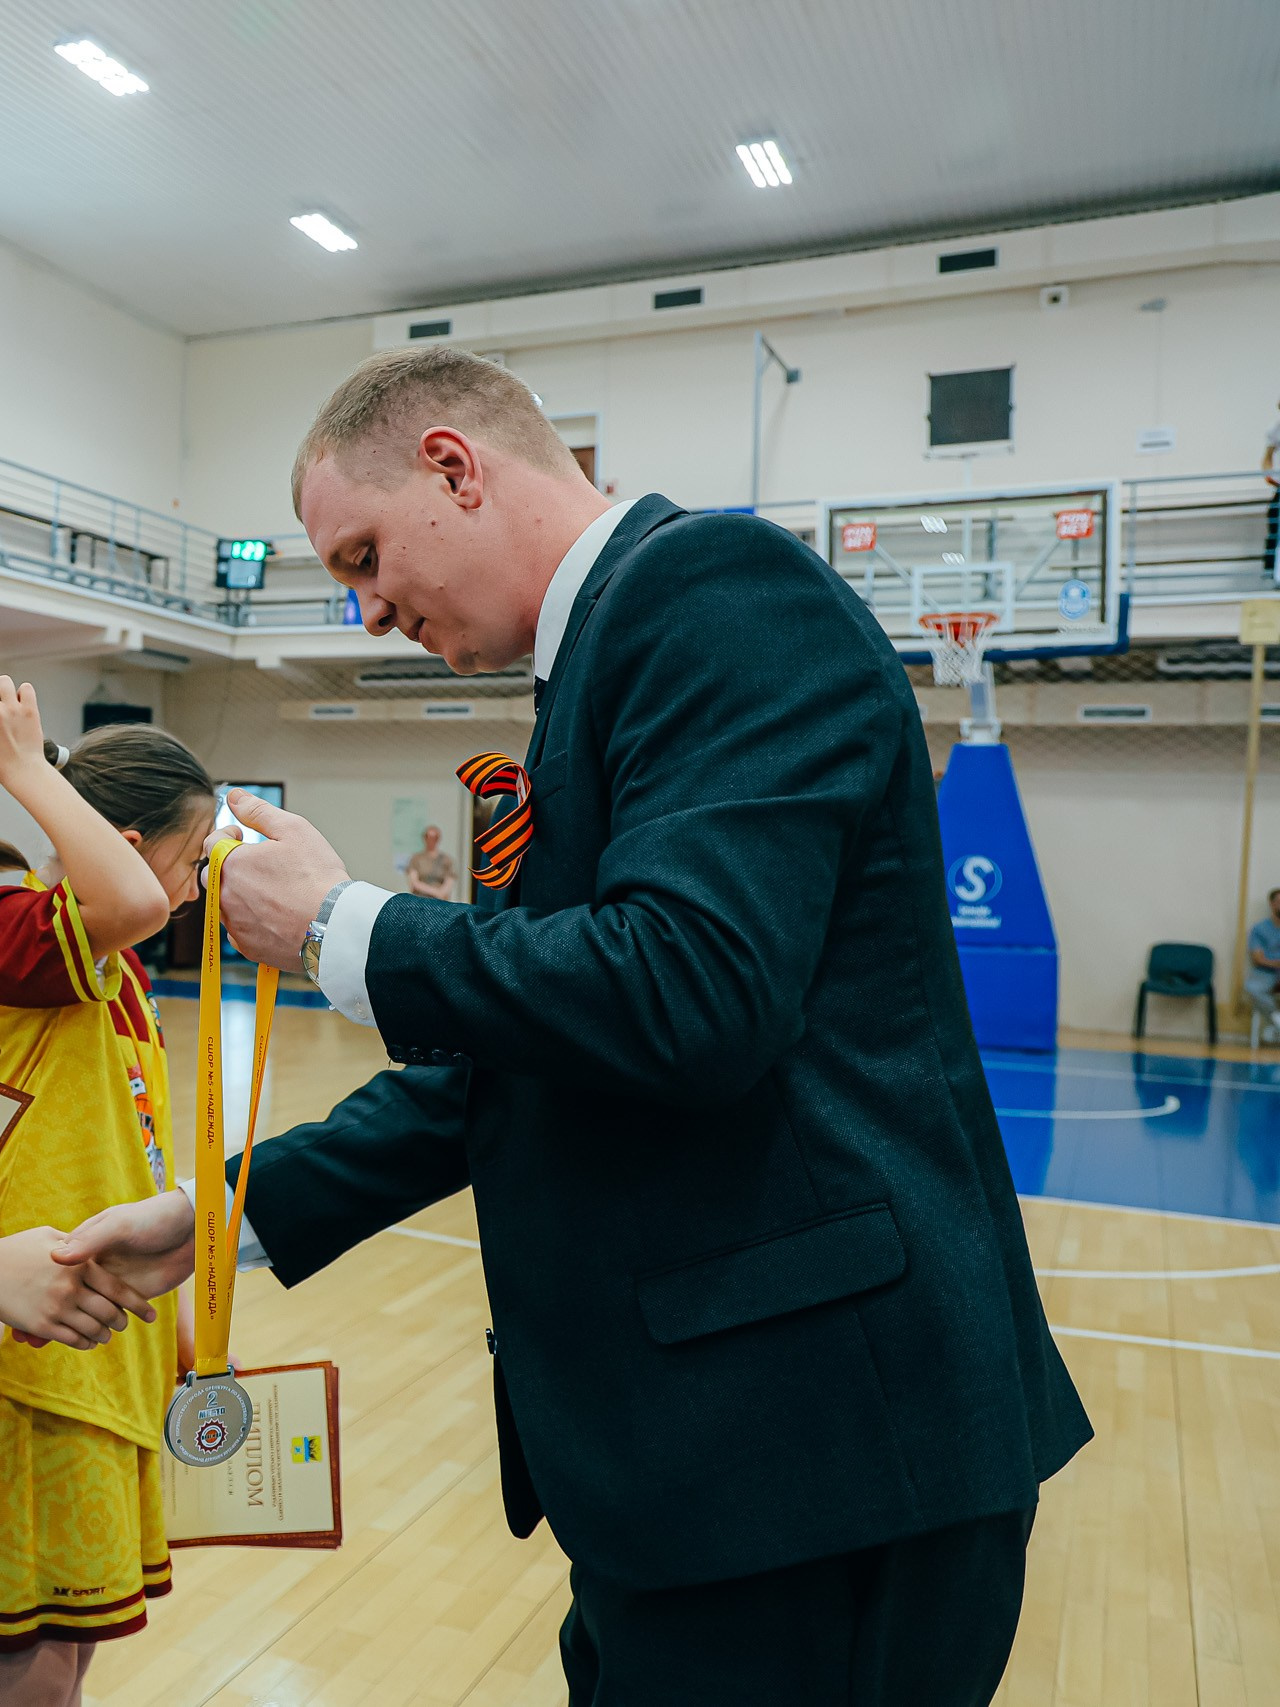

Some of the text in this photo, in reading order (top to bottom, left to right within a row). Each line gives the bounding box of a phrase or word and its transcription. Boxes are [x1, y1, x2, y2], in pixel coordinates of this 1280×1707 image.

[207, 1088, 215, 1150] «НАДЕЖДА»
[207, 1211, 218, 1320] СШОР №5 «НАДЕЖДА»
[207, 1391, 218, 1408] 2
